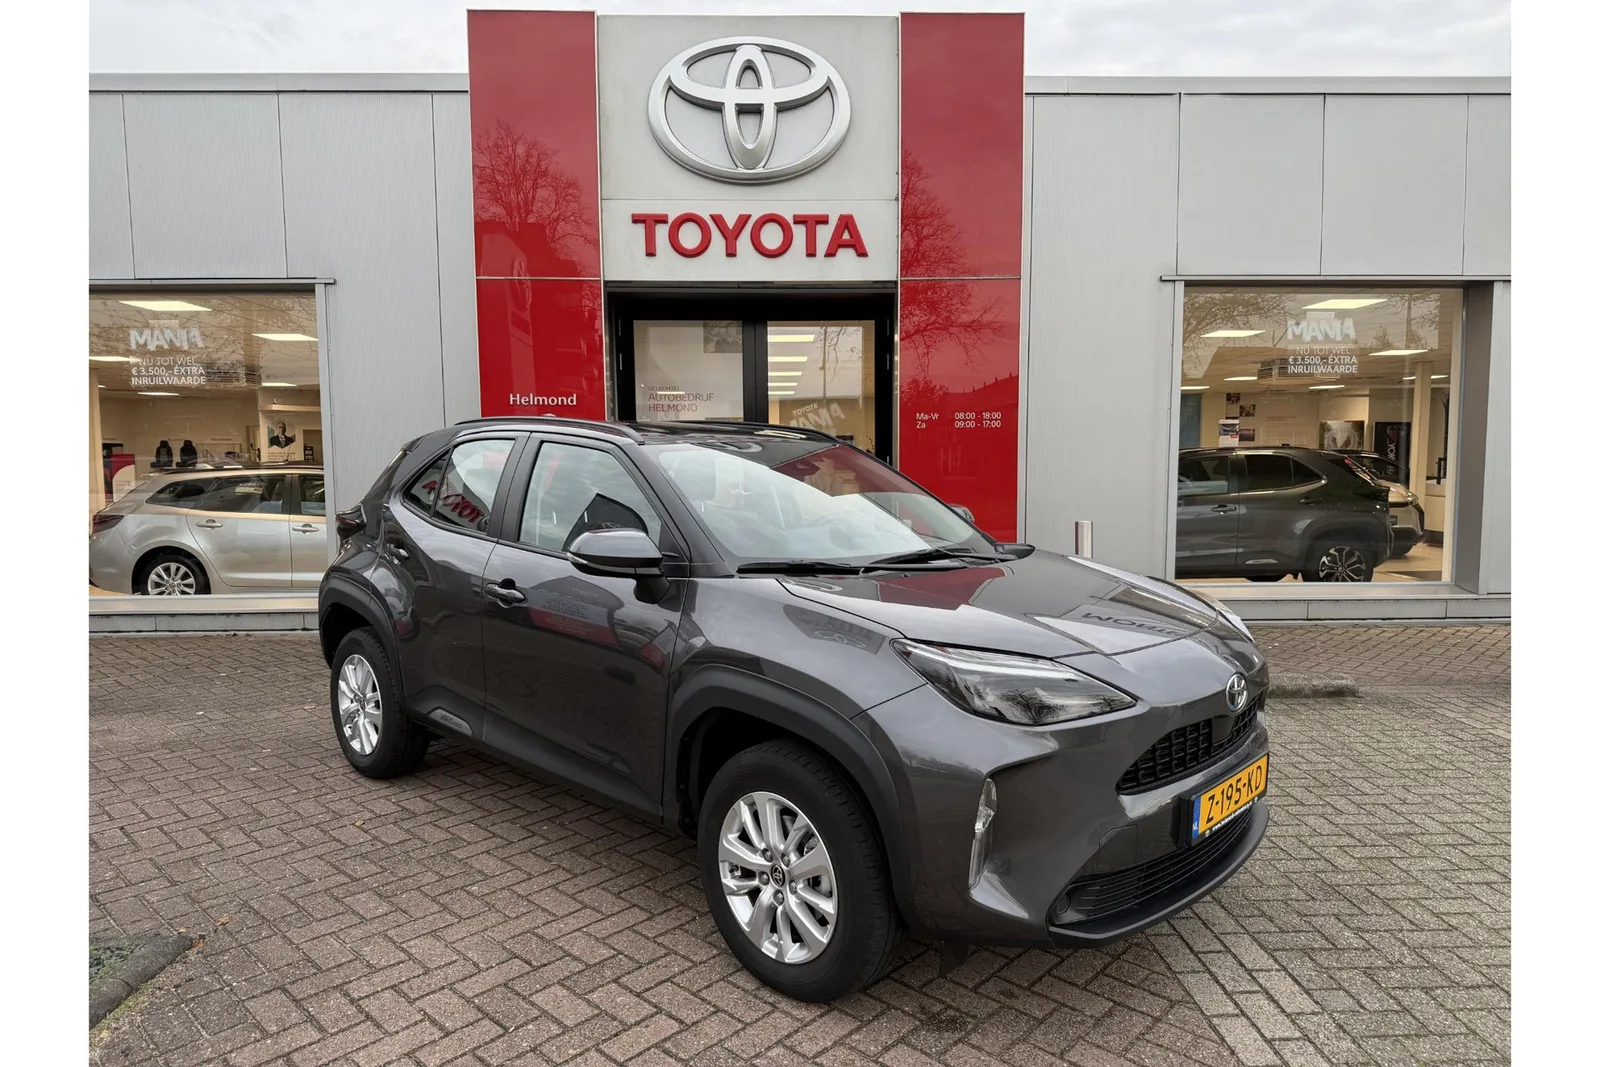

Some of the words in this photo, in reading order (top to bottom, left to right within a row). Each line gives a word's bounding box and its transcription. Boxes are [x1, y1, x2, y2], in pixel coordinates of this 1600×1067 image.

[631, 212, 869, 258] TOYOTA
[1286, 317, 1357, 343] MANIA
[129, 327, 205, 351] MANIA
[1296, 346, 1310, 355] NU
[1312, 346, 1330, 355] TOT
[1331, 346, 1351, 355] WEL
[156, 356, 174, 366] TOT
[176, 356, 197, 366] WEL
[1287, 365, 1358, 374] INRUILWAARDE
[131, 376, 207, 385] INRUILWAARDE
[509, 393, 577, 406] Helmond
[648, 403, 698, 412] HELMOND
[916, 412, 939, 420] Ma-Vr
[916, 421, 926, 429] Za
[982, 420, 1002, 428] 17:00
[1205, 764, 1263, 825] Z-195-KD
